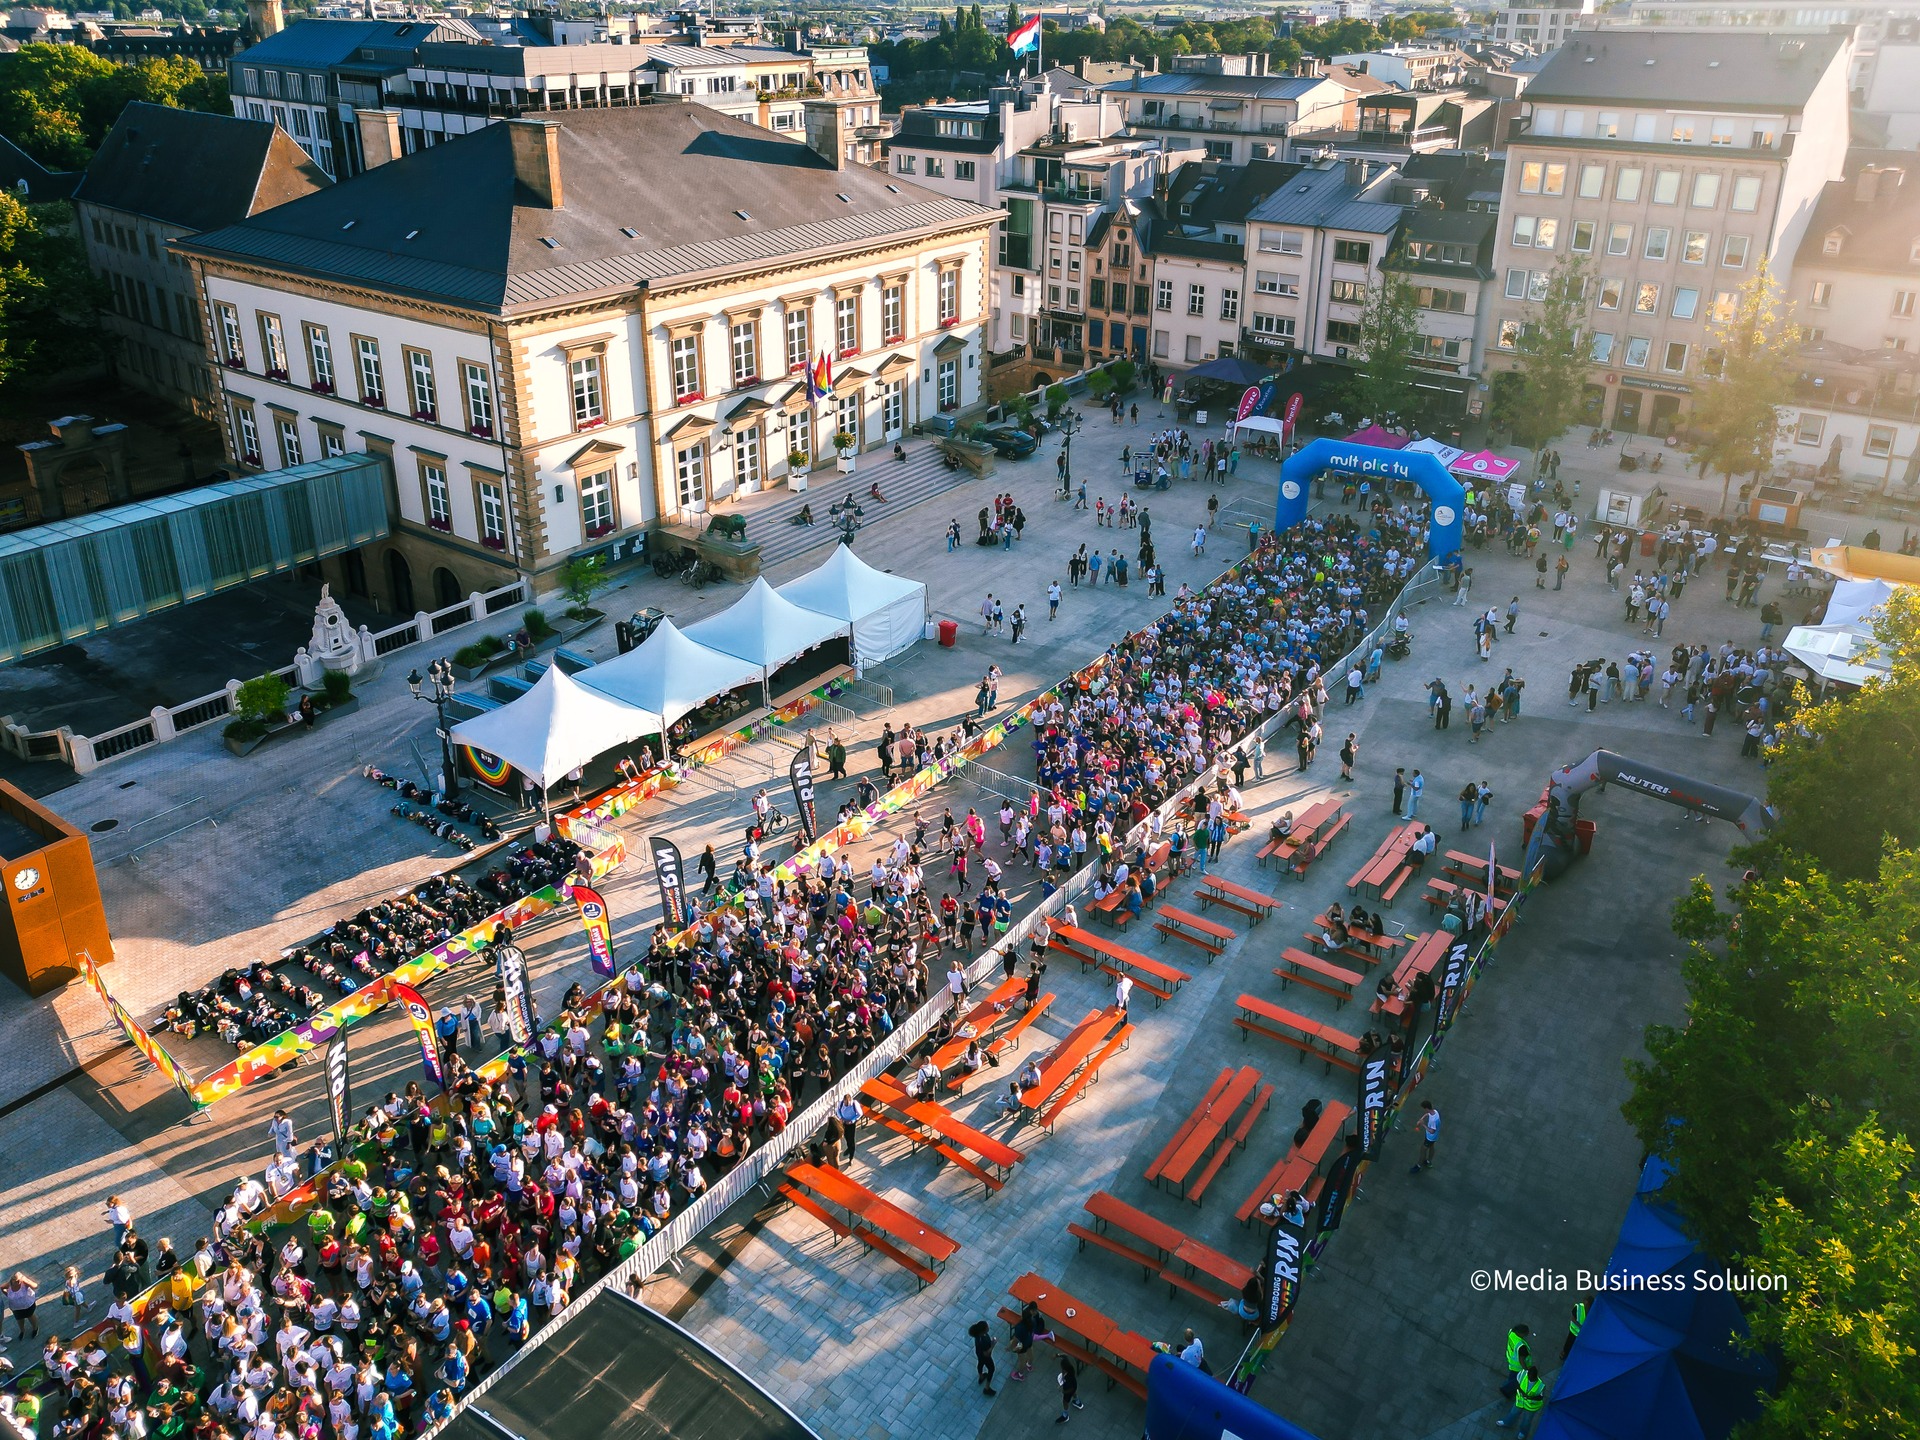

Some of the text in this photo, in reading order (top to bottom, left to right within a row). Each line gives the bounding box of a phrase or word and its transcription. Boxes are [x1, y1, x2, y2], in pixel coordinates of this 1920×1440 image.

[1263, 337, 1285, 347] Piazza
[1329, 454, 1409, 478] multiplicity
[794, 761, 814, 801] RUN
[1444, 943, 1468, 988] RUN
[329, 1041, 347, 1098] RUN
[1365, 1059, 1385, 1110] RUN
[1274, 1229, 1299, 1283] RUN
[1270, 1276, 1281, 1321] UXEMBOURG
